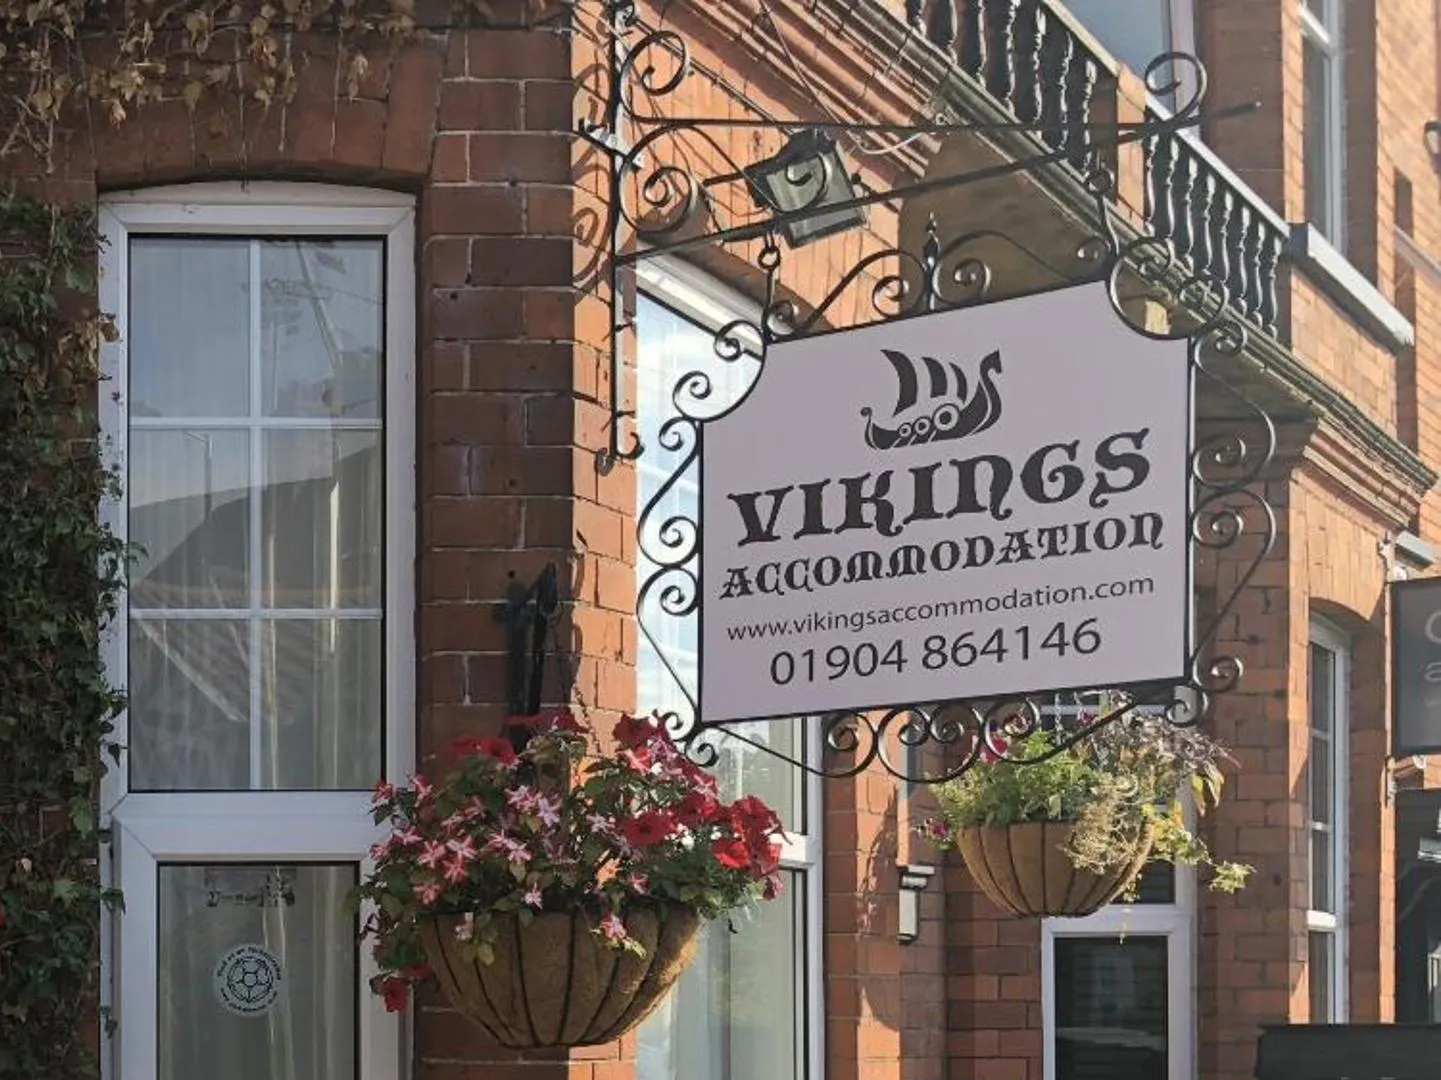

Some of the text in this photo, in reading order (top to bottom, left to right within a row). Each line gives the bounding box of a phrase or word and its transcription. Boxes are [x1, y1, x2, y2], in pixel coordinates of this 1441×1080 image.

[727, 427, 1150, 548] VIKINGS
[719, 512, 1164, 600] ACCOMMODATION
[727, 576, 1155, 642] www.vikingsaccommodation.com
[770, 618, 1103, 686] 01904 864146
